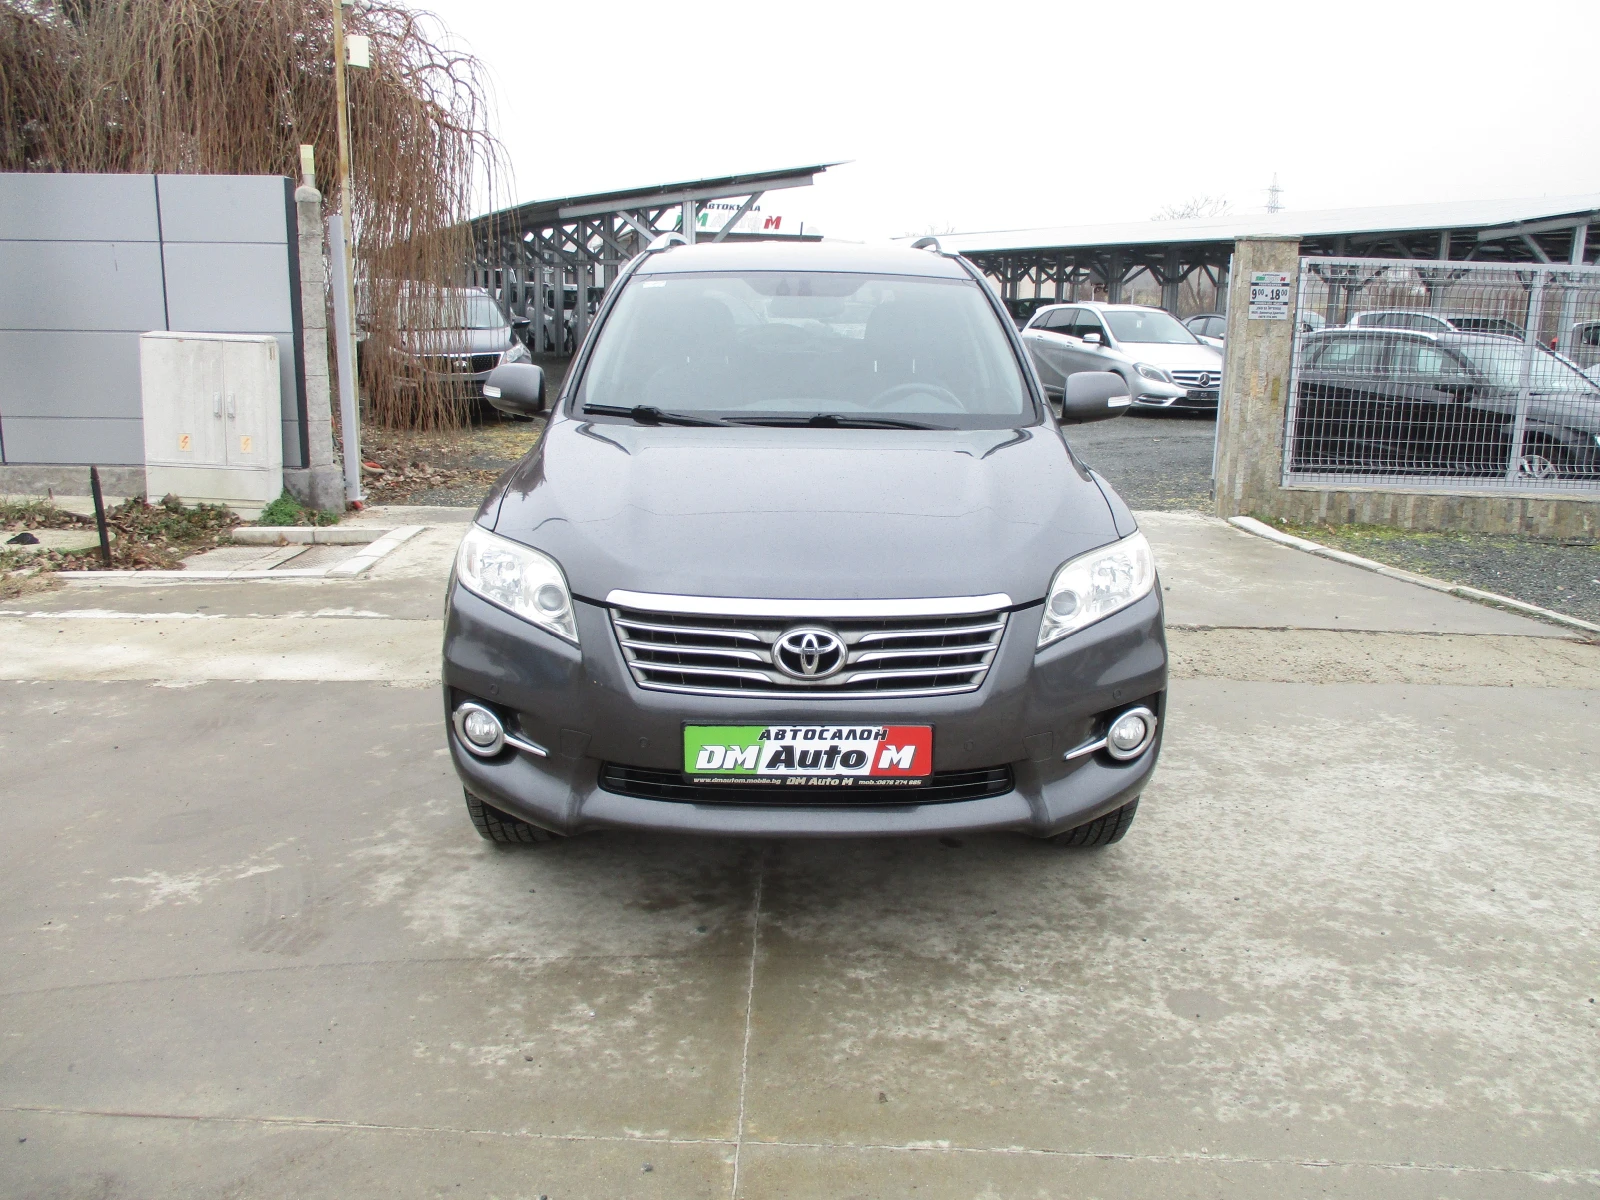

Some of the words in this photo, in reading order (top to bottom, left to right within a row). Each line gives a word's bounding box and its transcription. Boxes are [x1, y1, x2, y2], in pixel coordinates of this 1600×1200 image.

[763, 215, 782, 230] M
[758, 728, 888, 741] АВТОСАЛОН
[695, 744, 762, 770] DM
[765, 744, 869, 770] Auto
[877, 744, 916, 770] M
[786, 776, 807, 785] DM
[808, 777, 839, 786] Auto
[841, 777, 854, 786] M
